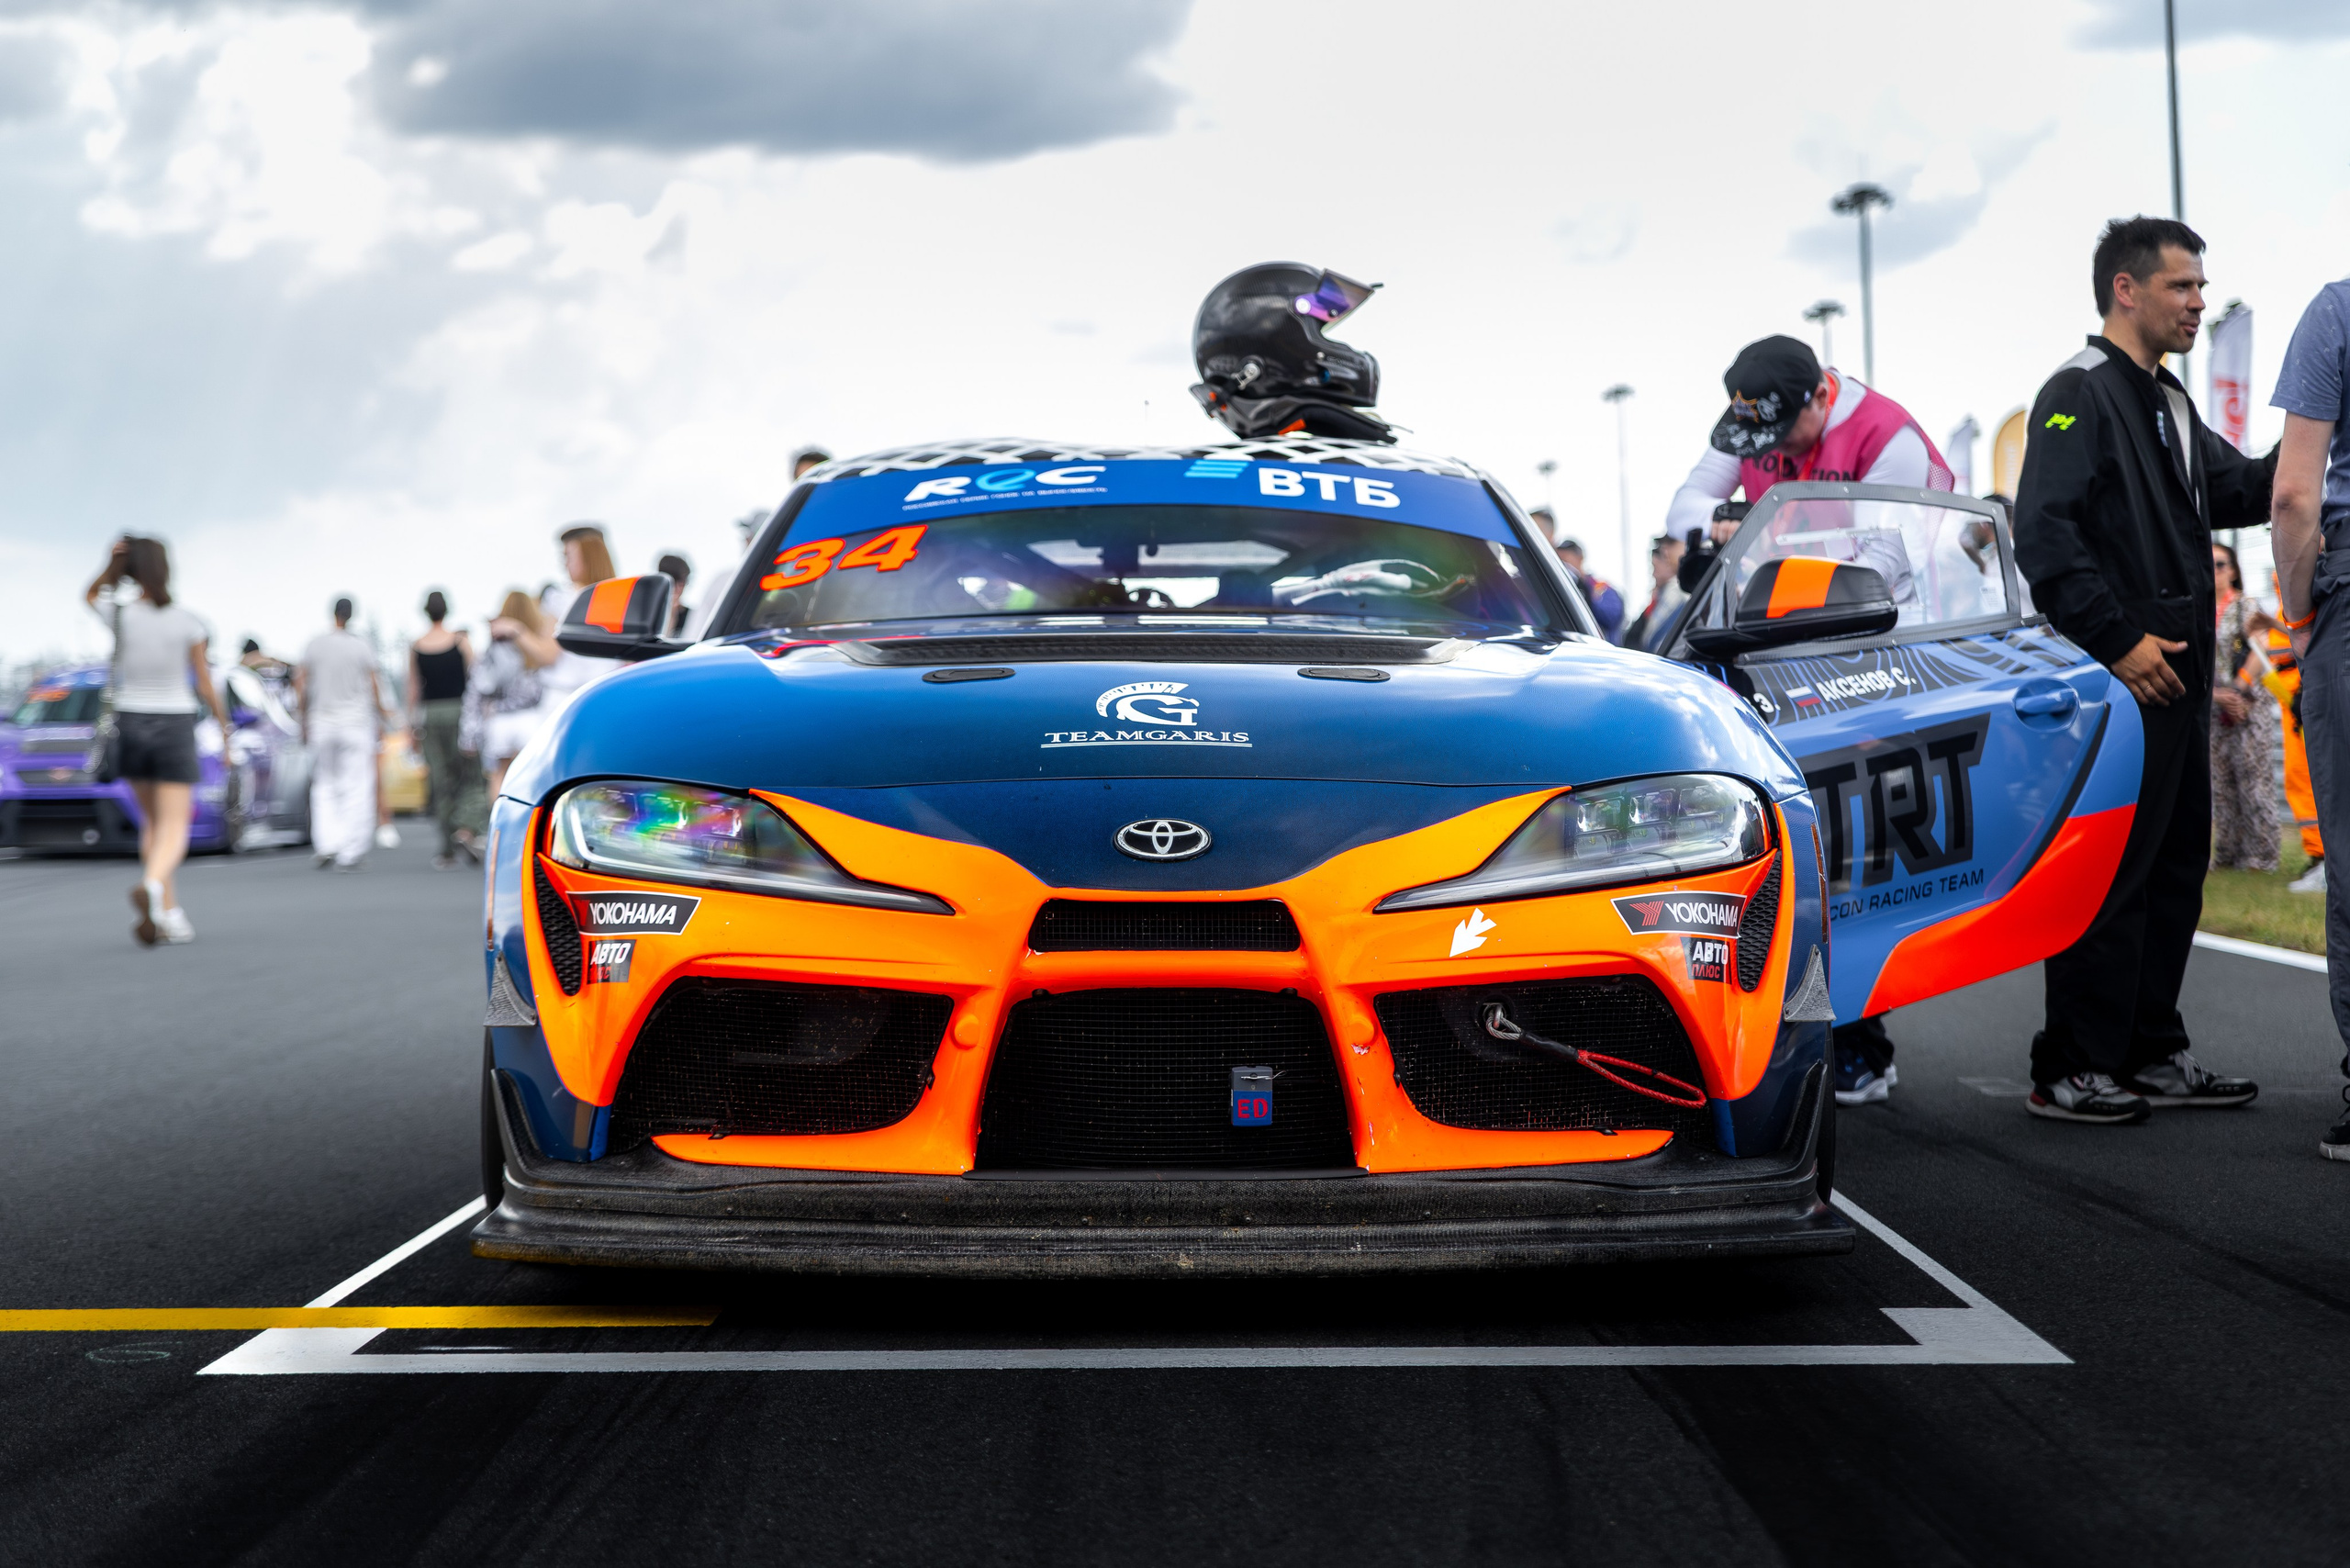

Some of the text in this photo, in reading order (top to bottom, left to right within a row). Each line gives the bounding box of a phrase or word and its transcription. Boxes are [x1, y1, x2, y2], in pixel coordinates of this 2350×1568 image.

[1259, 467, 1401, 508] ВТБ
[759, 524, 928, 591] 34
[1816, 669, 1897, 701] АКСЕНОВ
[1045, 730, 1249, 743] TEAMGARIS
[1869, 881, 1933, 911] RACING
[1940, 868, 1984, 894] TEAM
[589, 902, 677, 925] YOKOHAMA
[1664, 902, 1739, 927] YOKOHAMA
[590, 942, 632, 965] АВТО
[1692, 941, 1729, 965] АВТО
[1691, 963, 1720, 979] ПЛЮС
[1237, 1098, 1269, 1118] ED
